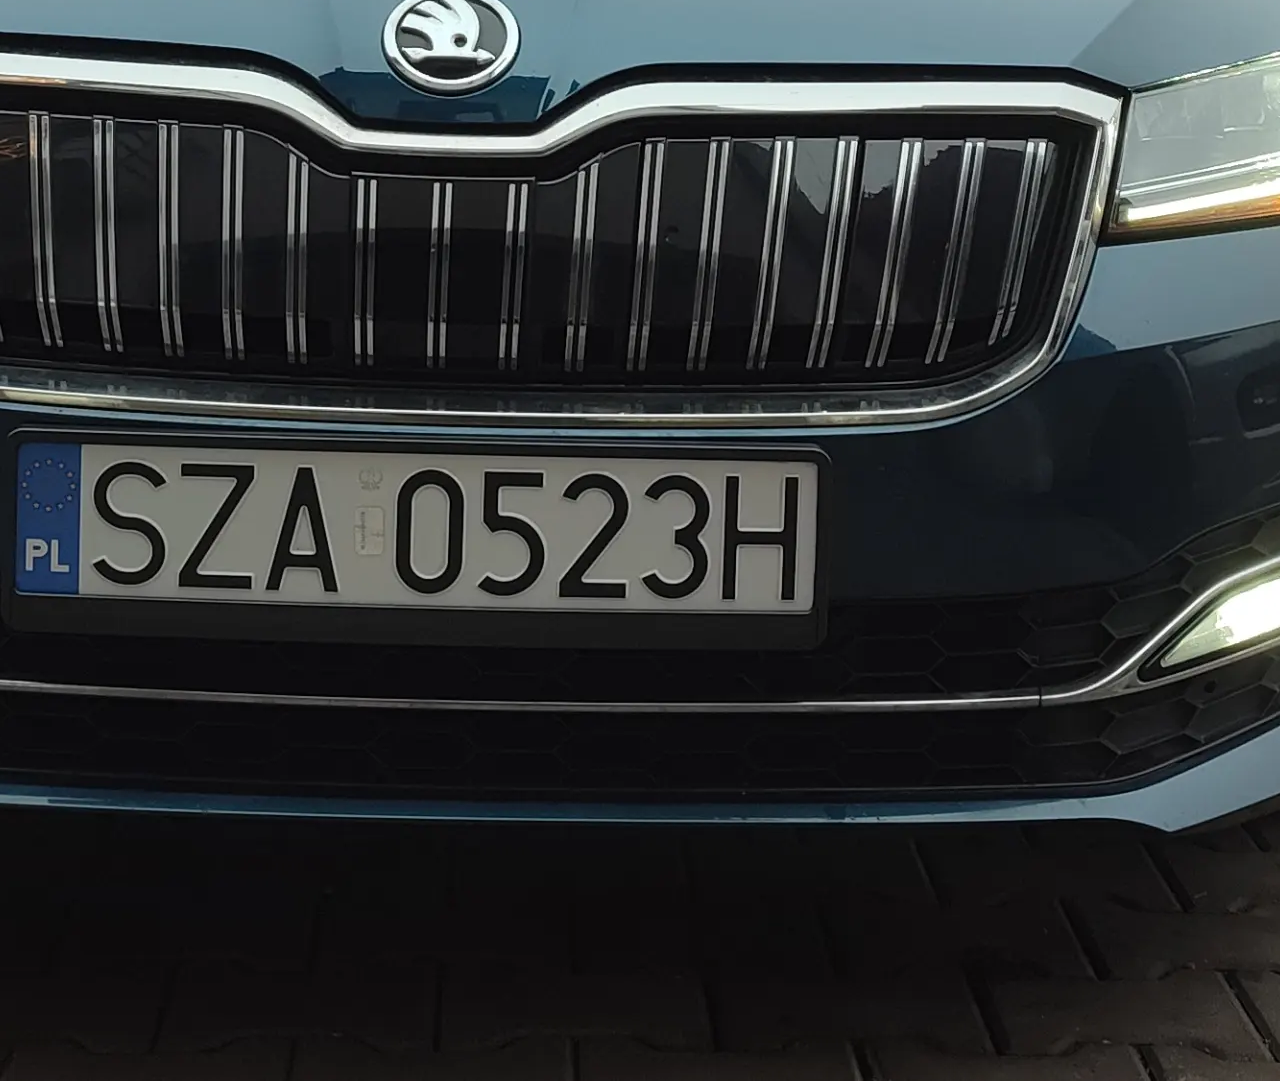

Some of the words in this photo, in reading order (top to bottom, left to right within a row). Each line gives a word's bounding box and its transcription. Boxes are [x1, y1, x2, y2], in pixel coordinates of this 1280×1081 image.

[25, 539, 70, 573] PL
[92, 460, 339, 593] SZA
[395, 468, 799, 601] 0523H
